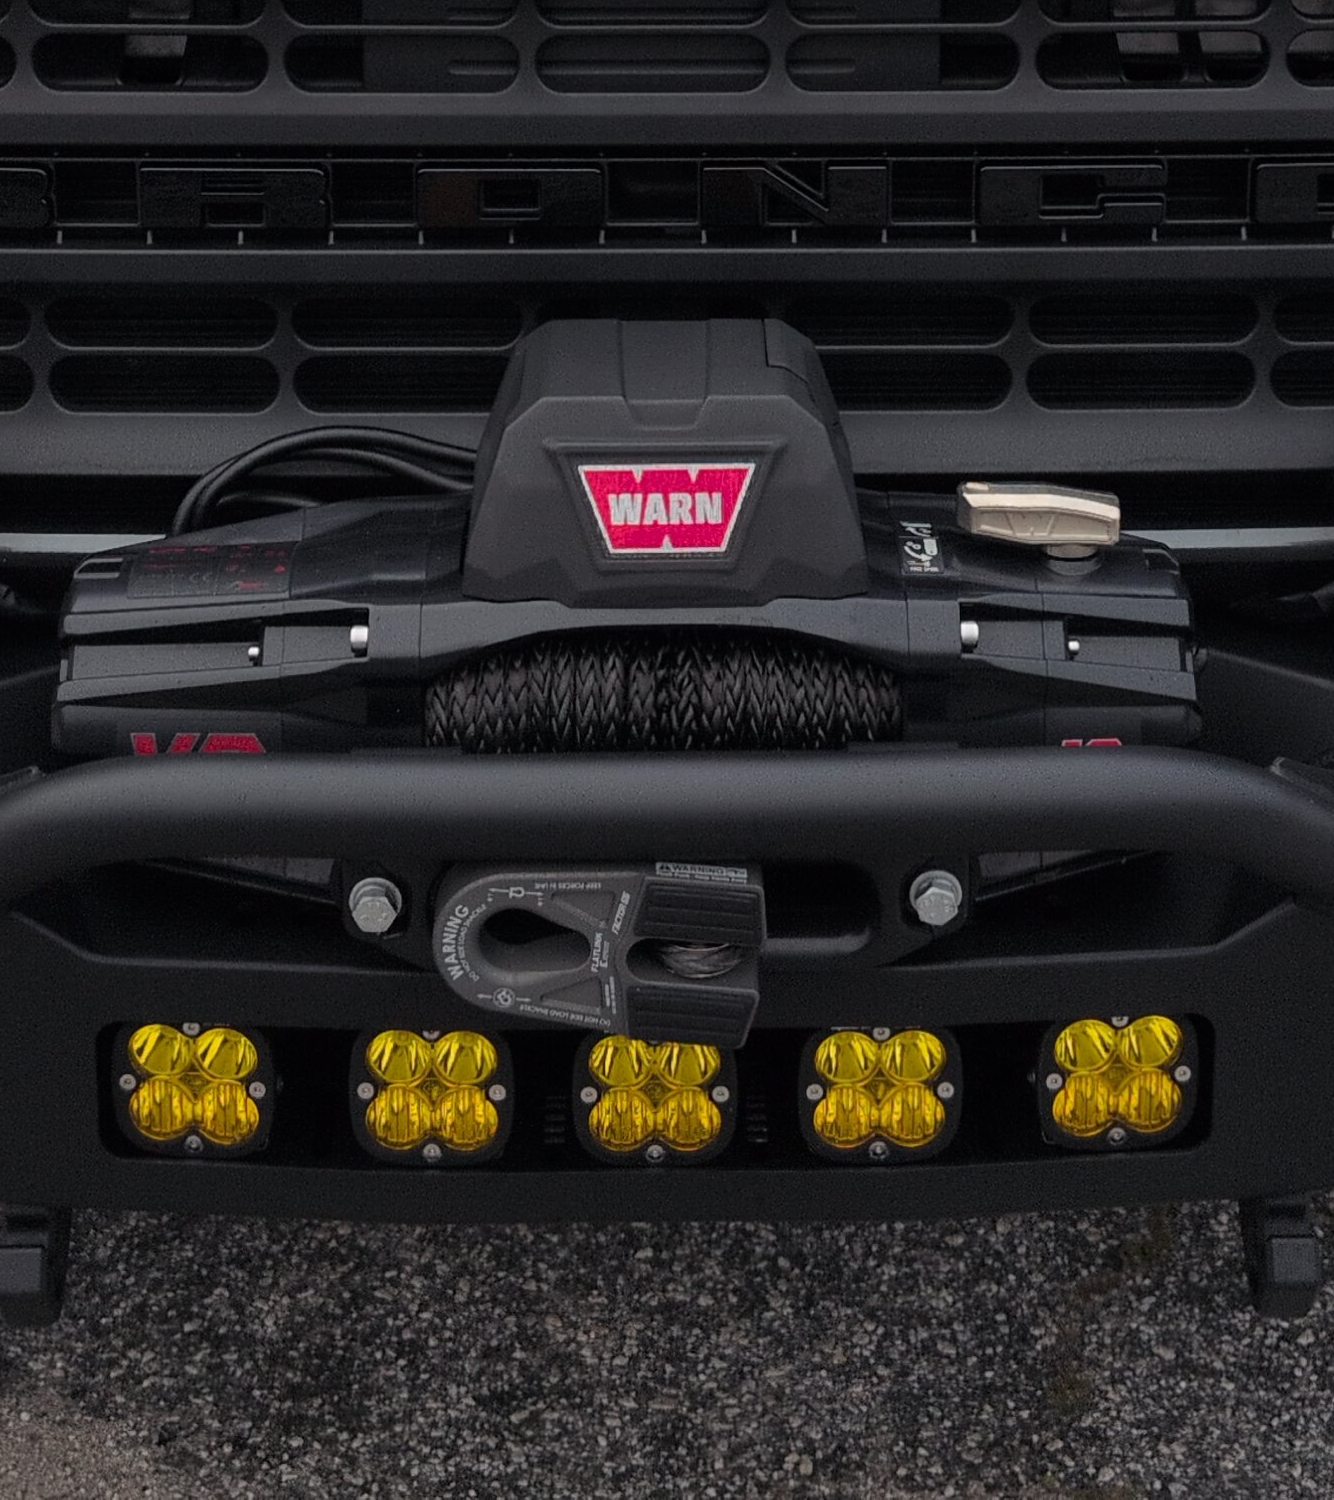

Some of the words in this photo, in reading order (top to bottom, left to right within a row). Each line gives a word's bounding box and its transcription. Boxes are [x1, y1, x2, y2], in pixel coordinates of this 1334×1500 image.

[608, 491, 723, 526] WARN
[670, 862, 725, 875] WARNING
[442, 904, 470, 981] WARNING
